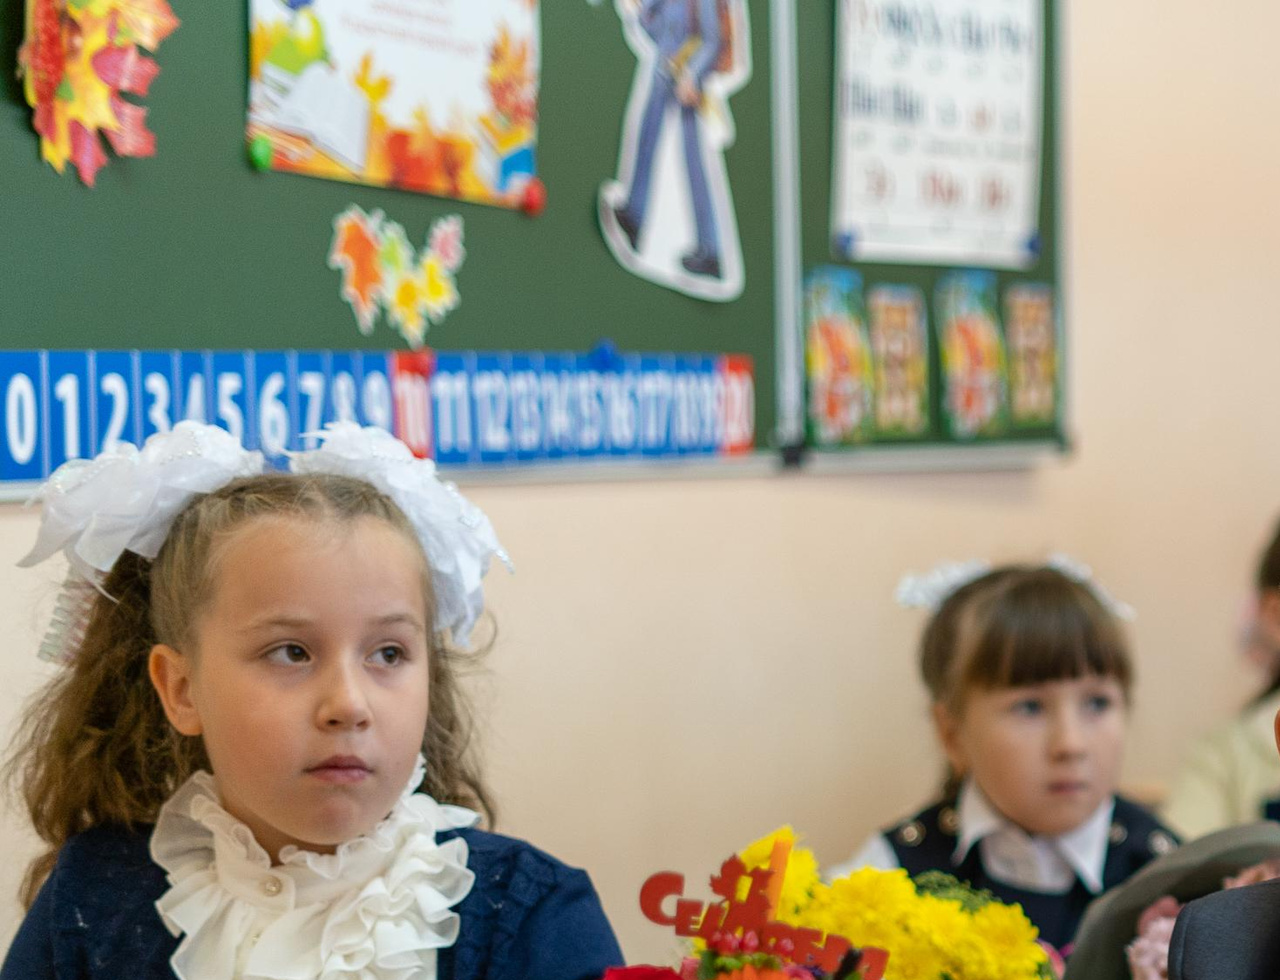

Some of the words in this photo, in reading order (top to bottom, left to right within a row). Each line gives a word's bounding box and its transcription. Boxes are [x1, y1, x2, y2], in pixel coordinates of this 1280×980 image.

[7, 373, 37, 464] 0
[55, 374, 79, 459] 1
[102, 373, 129, 451] 2
[145, 372, 171, 433] 3
[217, 372, 243, 447] 5
[260, 372, 288, 457] 6
[300, 372, 324, 450] 7
[433, 373, 471, 452] 11
